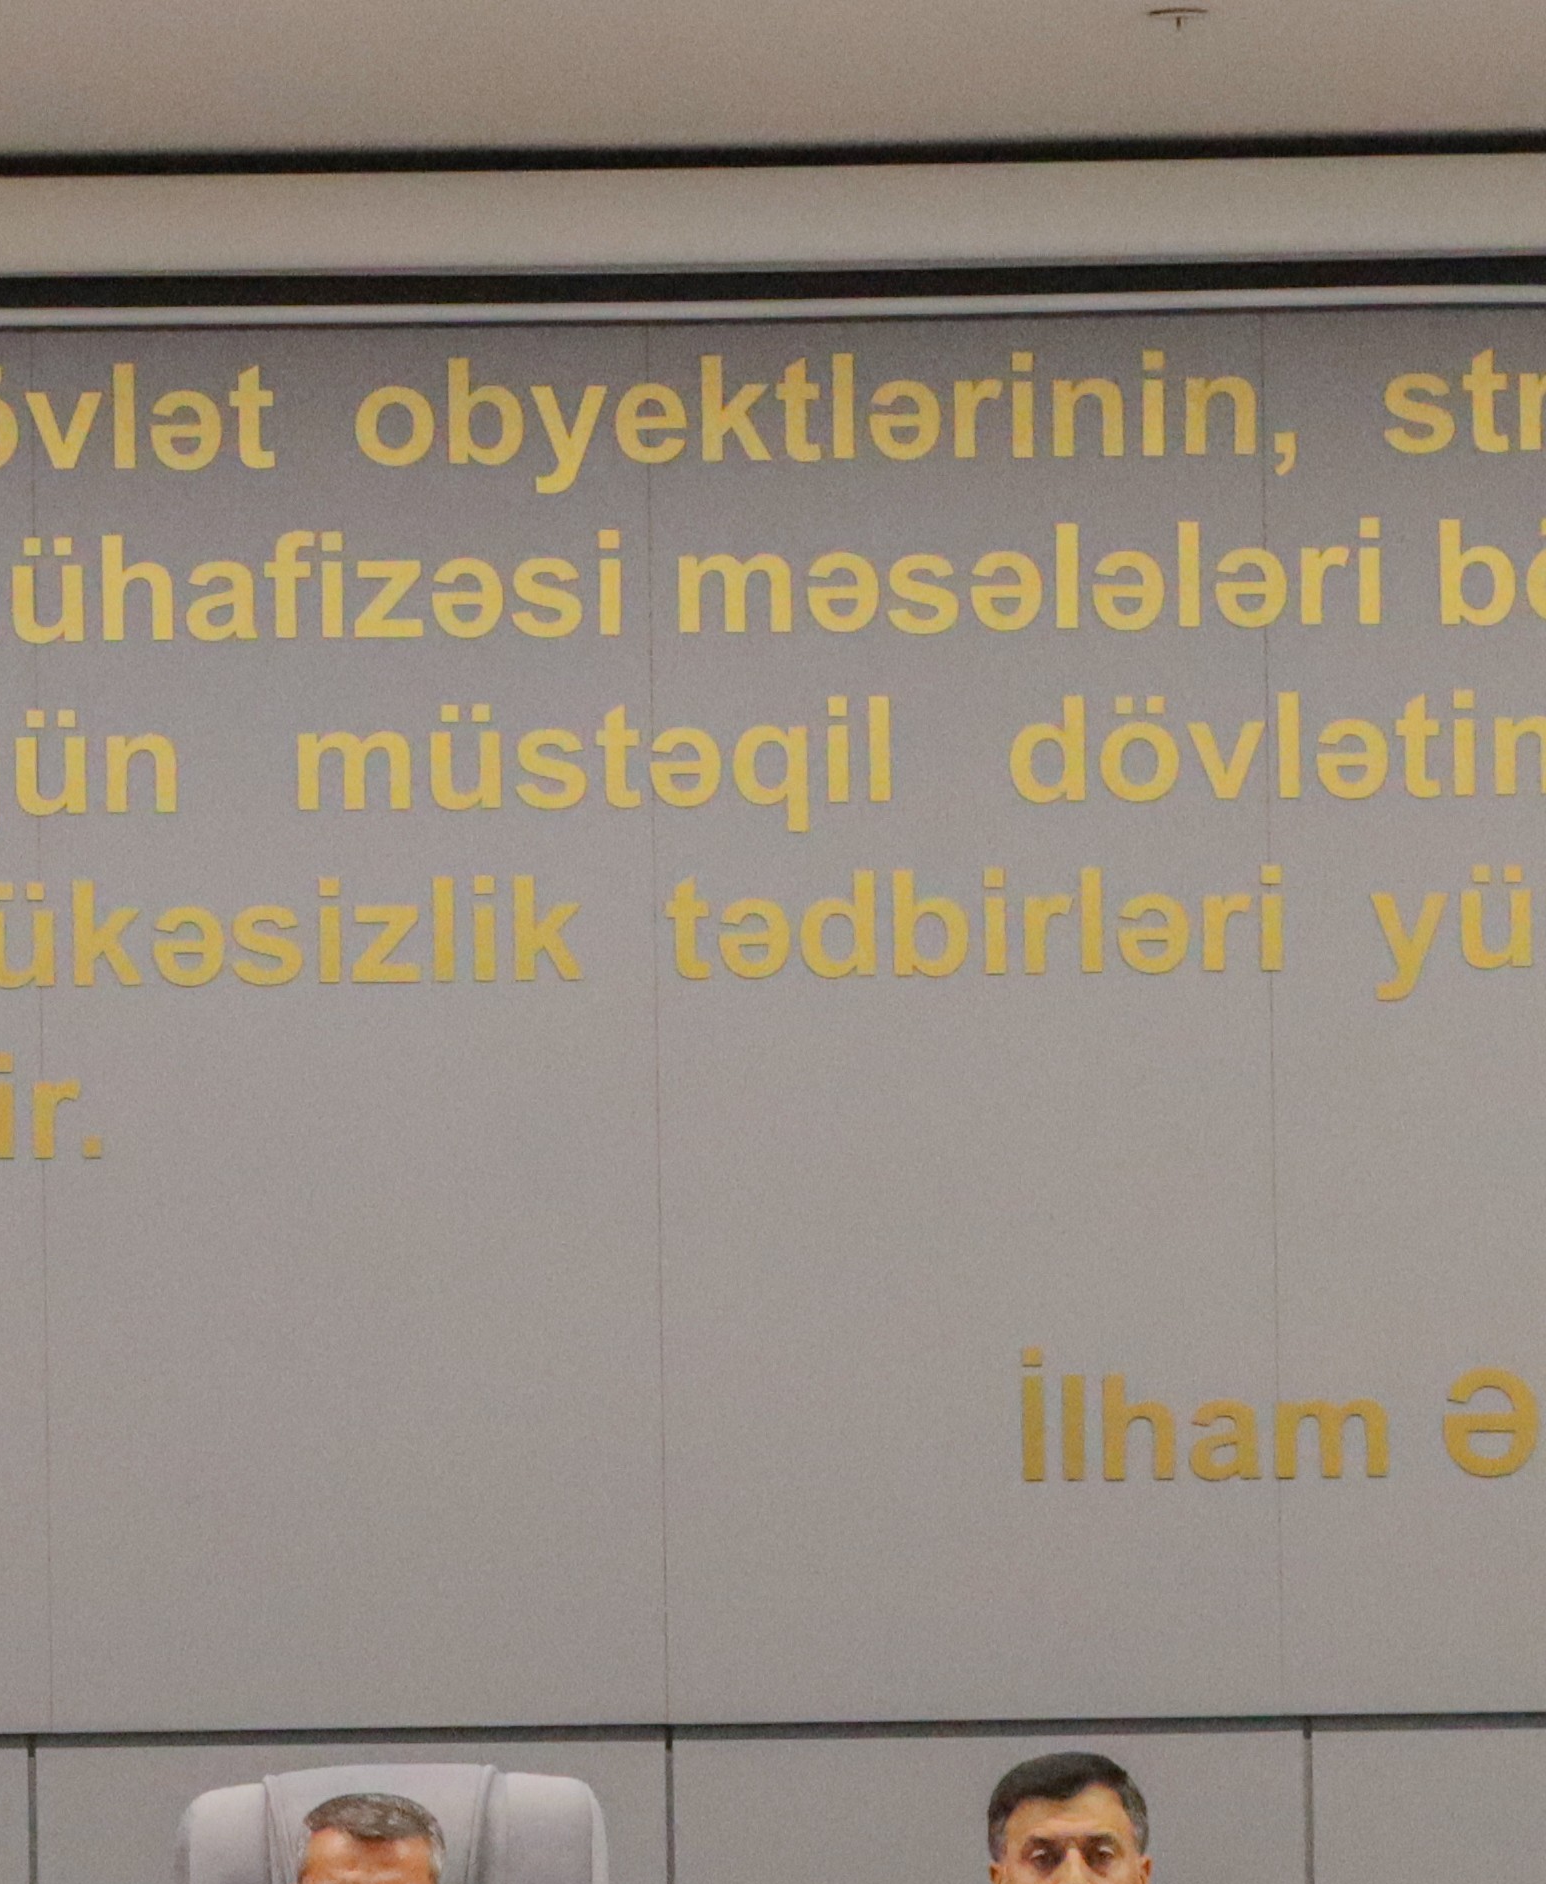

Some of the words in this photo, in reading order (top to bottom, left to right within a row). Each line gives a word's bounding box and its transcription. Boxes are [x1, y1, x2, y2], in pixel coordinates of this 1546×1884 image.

[354, 348, 1298, 495] obyektlərinin,
[677, 515, 1383, 636] məsələləri
[297, 694, 893, 833] müstəqil
[665, 864, 1285, 982] tədbirləri
[1022, 1345, 1390, 1483] İlham
